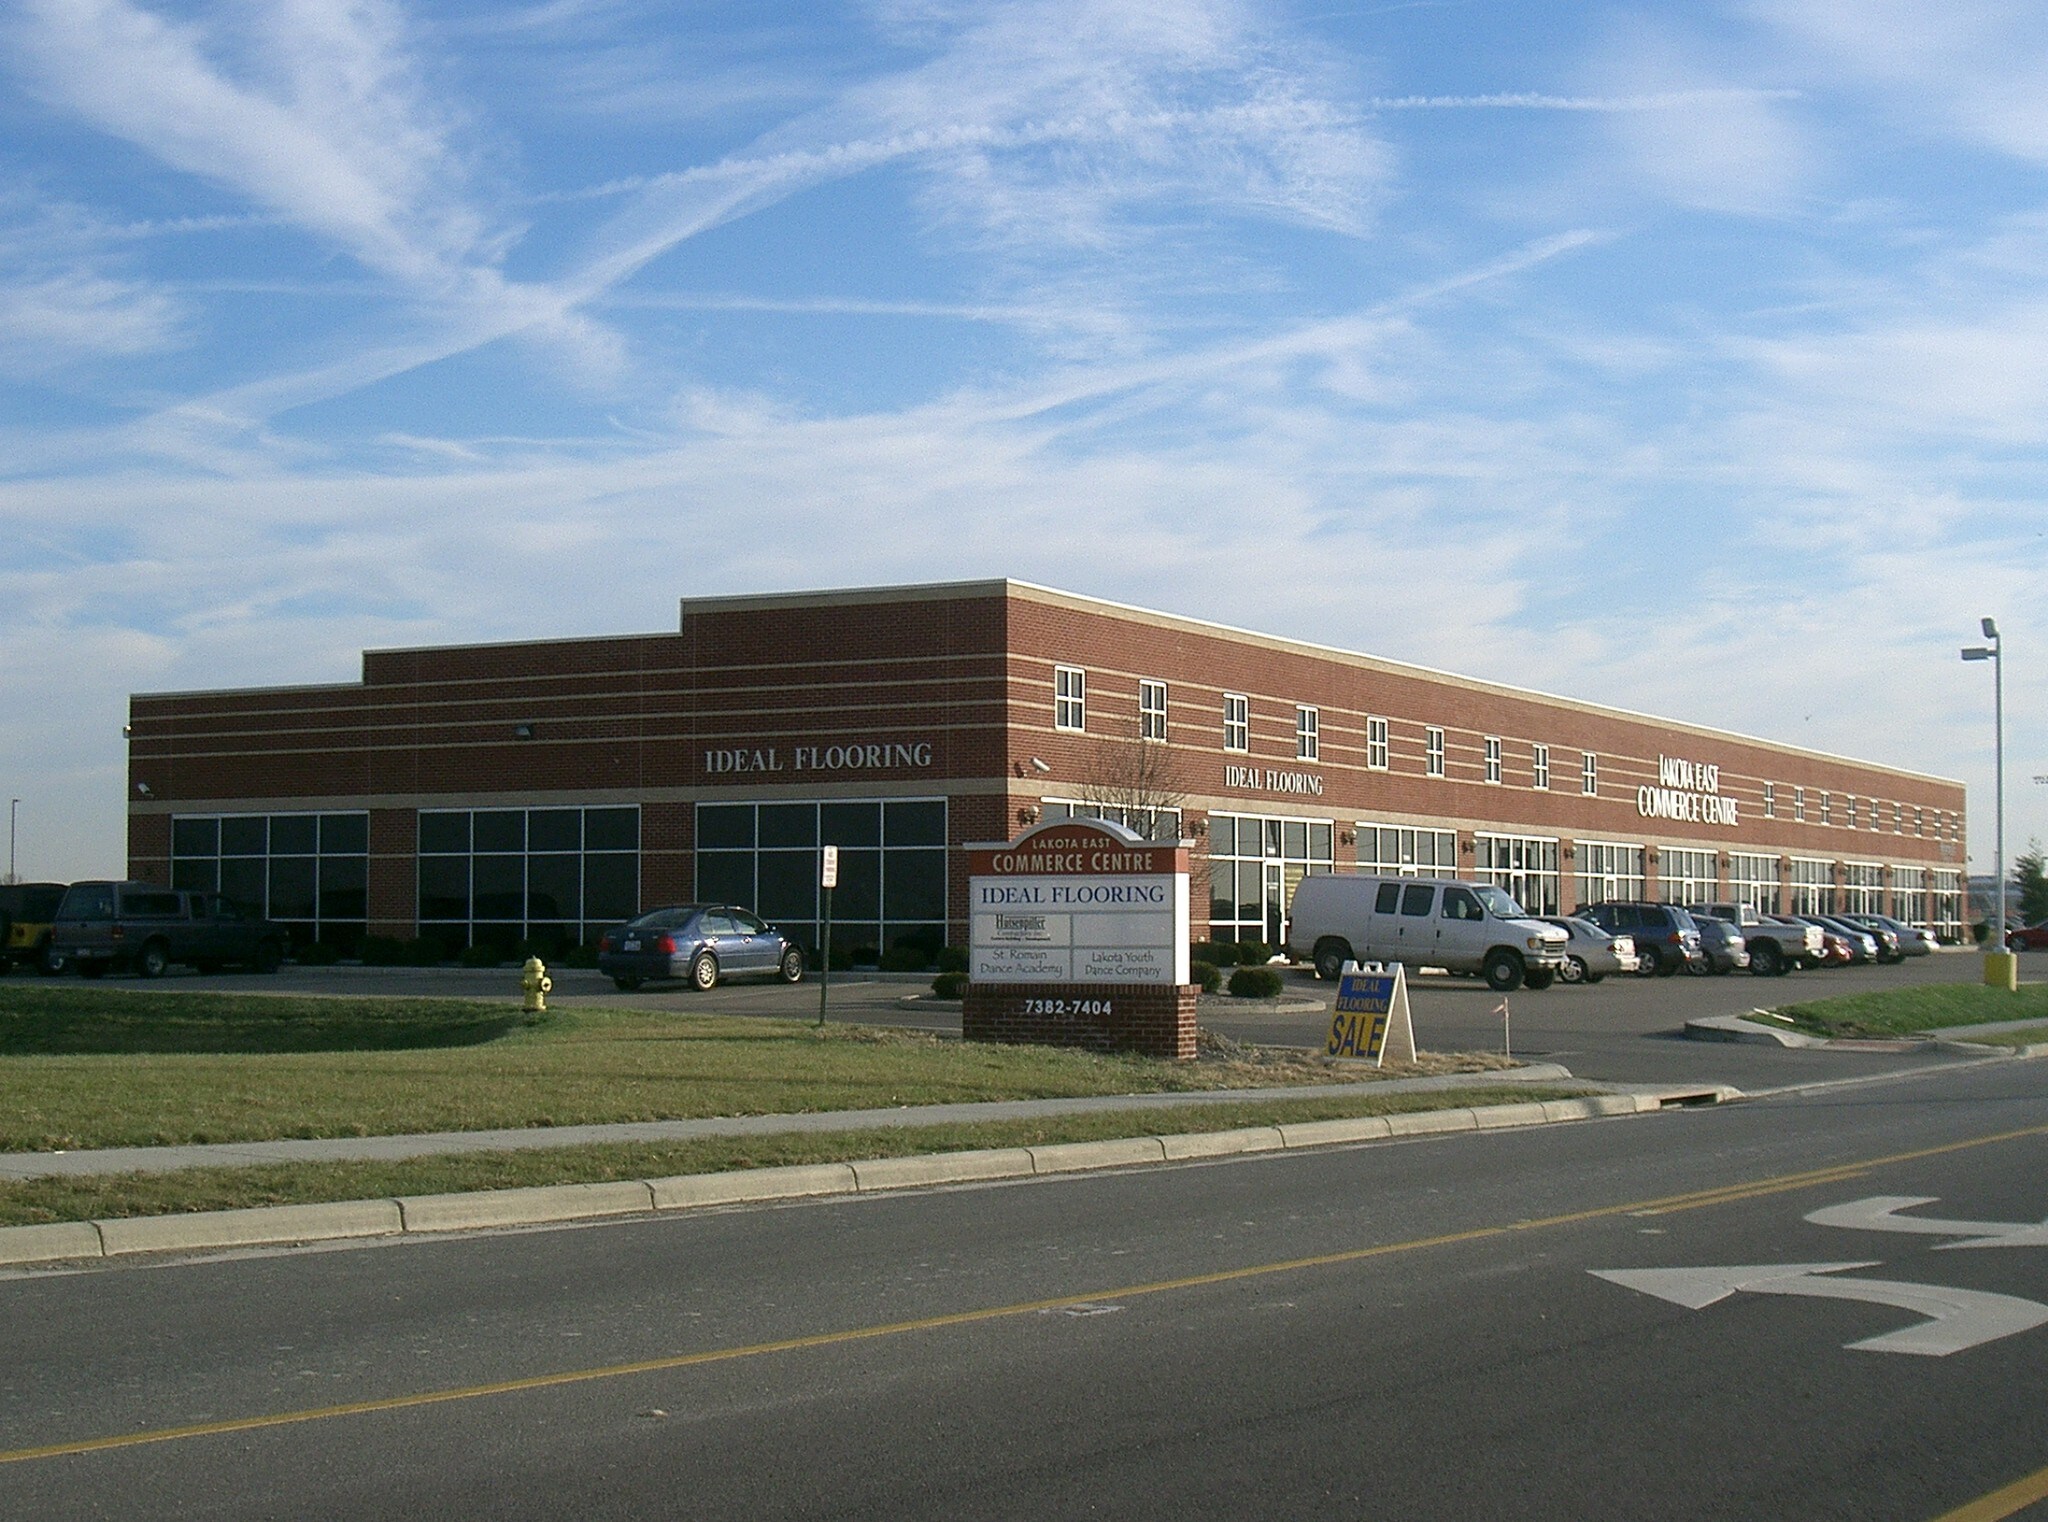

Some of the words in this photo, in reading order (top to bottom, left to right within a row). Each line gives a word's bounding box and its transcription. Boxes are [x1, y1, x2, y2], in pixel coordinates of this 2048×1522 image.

[705, 749, 783, 773] IDEAL
[795, 742, 932, 770] FLOORING
[1225, 765, 1262, 789] IDEAL
[1265, 770, 1323, 795] FLOORING
[1659, 753, 1694, 790] LAKOTA
[1695, 763, 1719, 793] EAST
[1638, 785, 1700, 822] COMMERCE
[1702, 794, 1739, 826] CENTRE
[1032, 839, 1077, 849] LAKOTA
[1082, 838, 1111, 848] EAST
[992, 854, 1083, 873] COMMERCE
[1091, 852, 1153, 871] CENTRE
[981, 887, 1046, 904] IDEAL
[1051, 885, 1165, 903] FLOORING
[1010, 949, 1047, 960] Romain
[1092, 951, 1123, 963] Lakota
[1125, 949, 1154, 962] Youth
[980, 962, 1012, 974] Dance
[1016, 960, 1063, 978] Academy
[1085, 964, 1113, 975] Dance
[1115, 964, 1161, 978] Company
[1352, 978, 1380, 993] IDEAL
[1025, 1000, 1112, 1016] 7382-7404
[1338, 996, 1388, 1012] FLOORING
[1329, 1014, 1385, 1057] SALE
